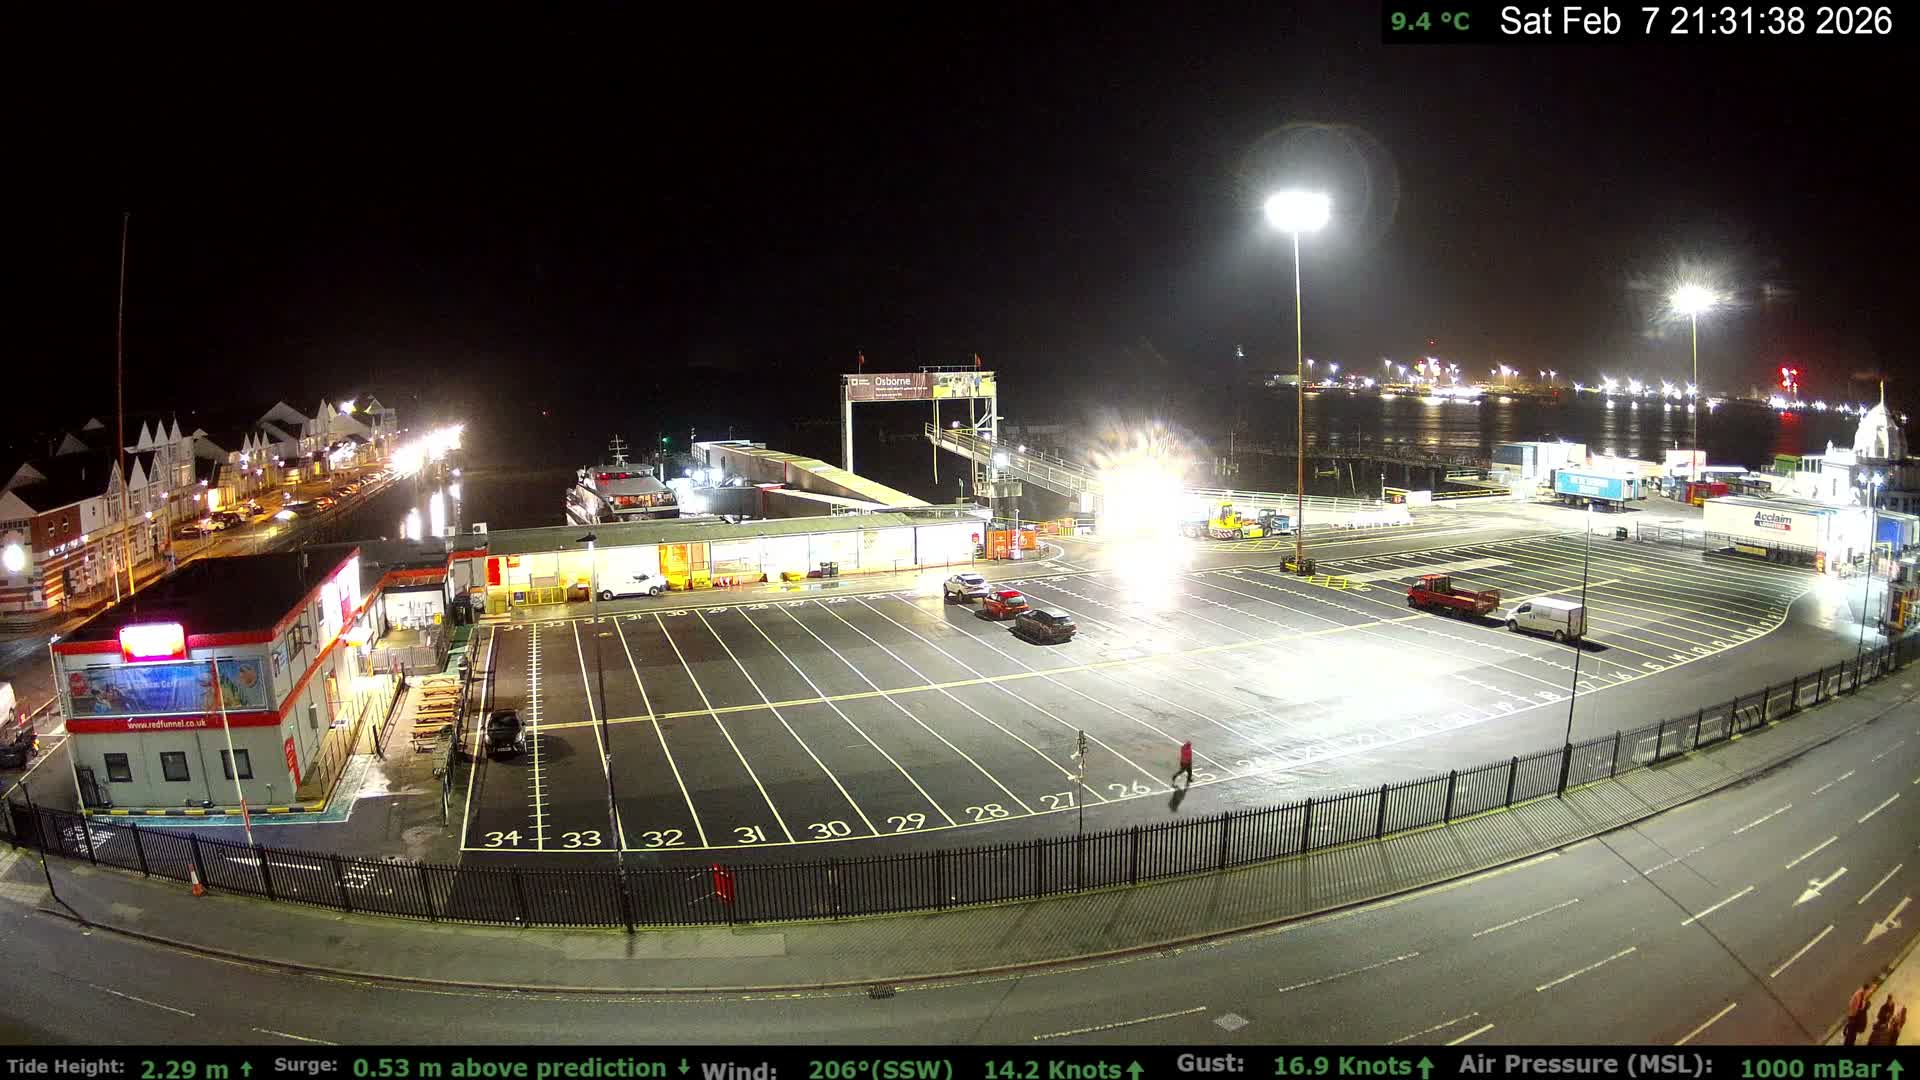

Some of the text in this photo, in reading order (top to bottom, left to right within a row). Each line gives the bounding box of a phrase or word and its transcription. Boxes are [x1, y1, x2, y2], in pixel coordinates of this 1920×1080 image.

[875, 377, 911, 386] Osborne
[1754, 511, 1792, 524] Acclaim
[127, 718, 207, 730] www.redfunnel.co.uk
[1108, 782, 1152, 799] 26
[1040, 791, 1076, 811] 27
[965, 803, 1010, 822] 28
[807, 820, 852, 839] 30
[887, 813, 927, 833] 29
[484, 830, 523, 848] 34
[561, 830, 603, 848] 33
[642, 829, 686, 847] 32
[733, 825, 767, 844] 31
